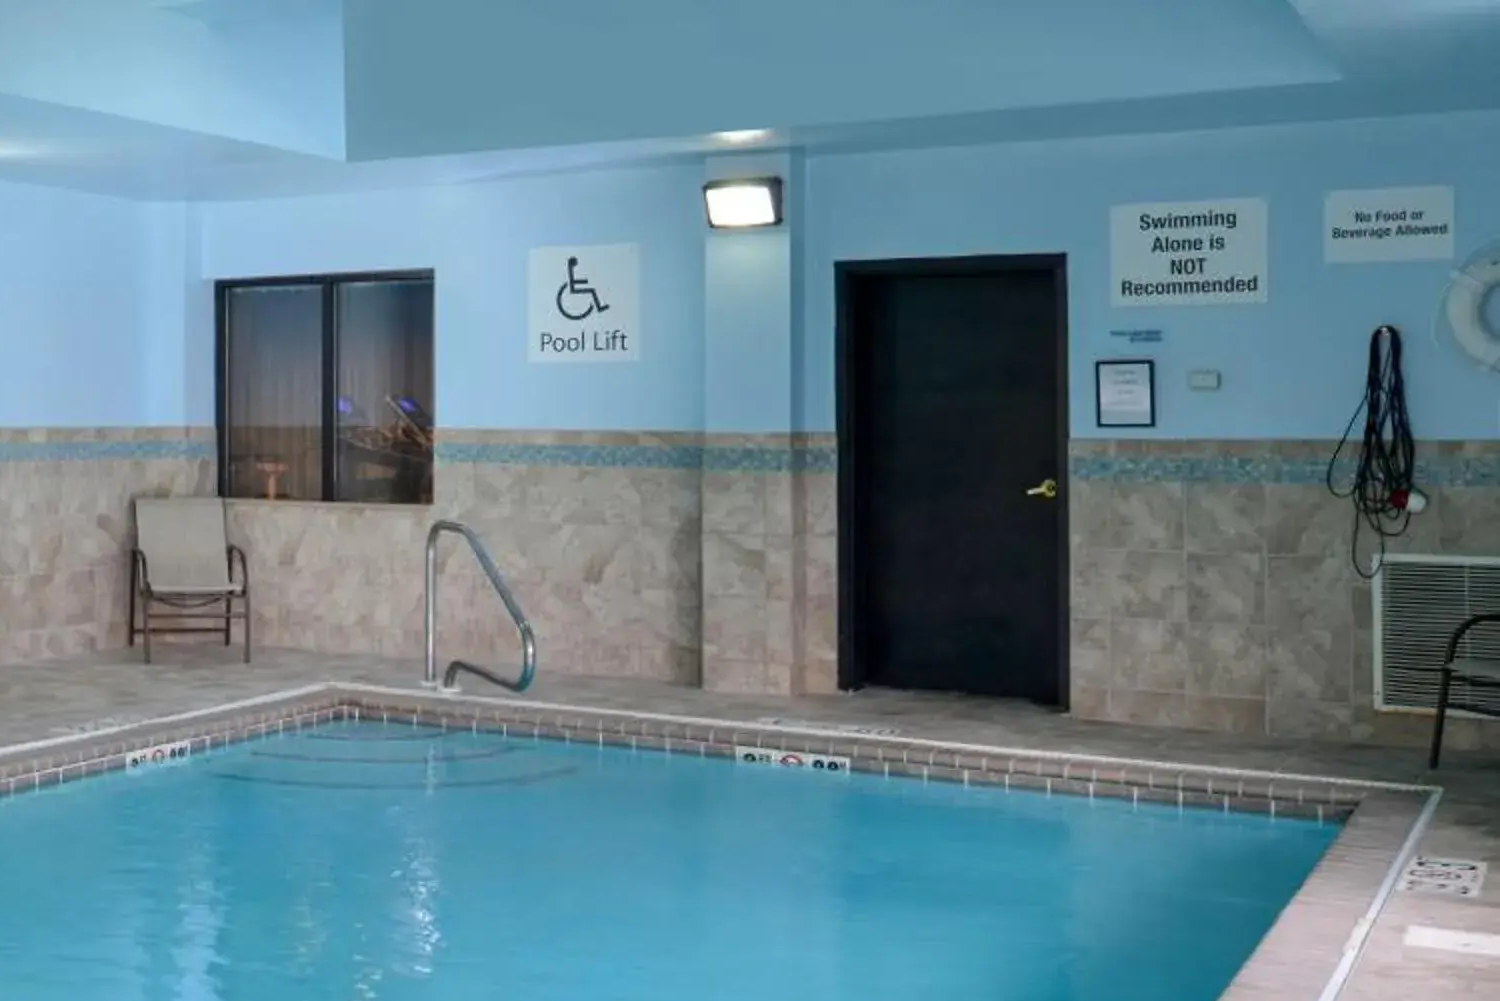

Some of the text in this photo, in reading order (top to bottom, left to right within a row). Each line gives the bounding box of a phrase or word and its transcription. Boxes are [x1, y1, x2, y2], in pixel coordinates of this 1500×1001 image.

[1139, 210, 1237, 231] Swimming
[1354, 210, 1372, 222] No
[1375, 209, 1407, 221] Food
[1331, 223, 1449, 239] Beverage Allowed
[1151, 234, 1225, 252] Alone is
[1170, 257, 1207, 275] NOT
[1121, 275, 1258, 296] Recommended
[540, 329, 628, 352] Pool Lift
